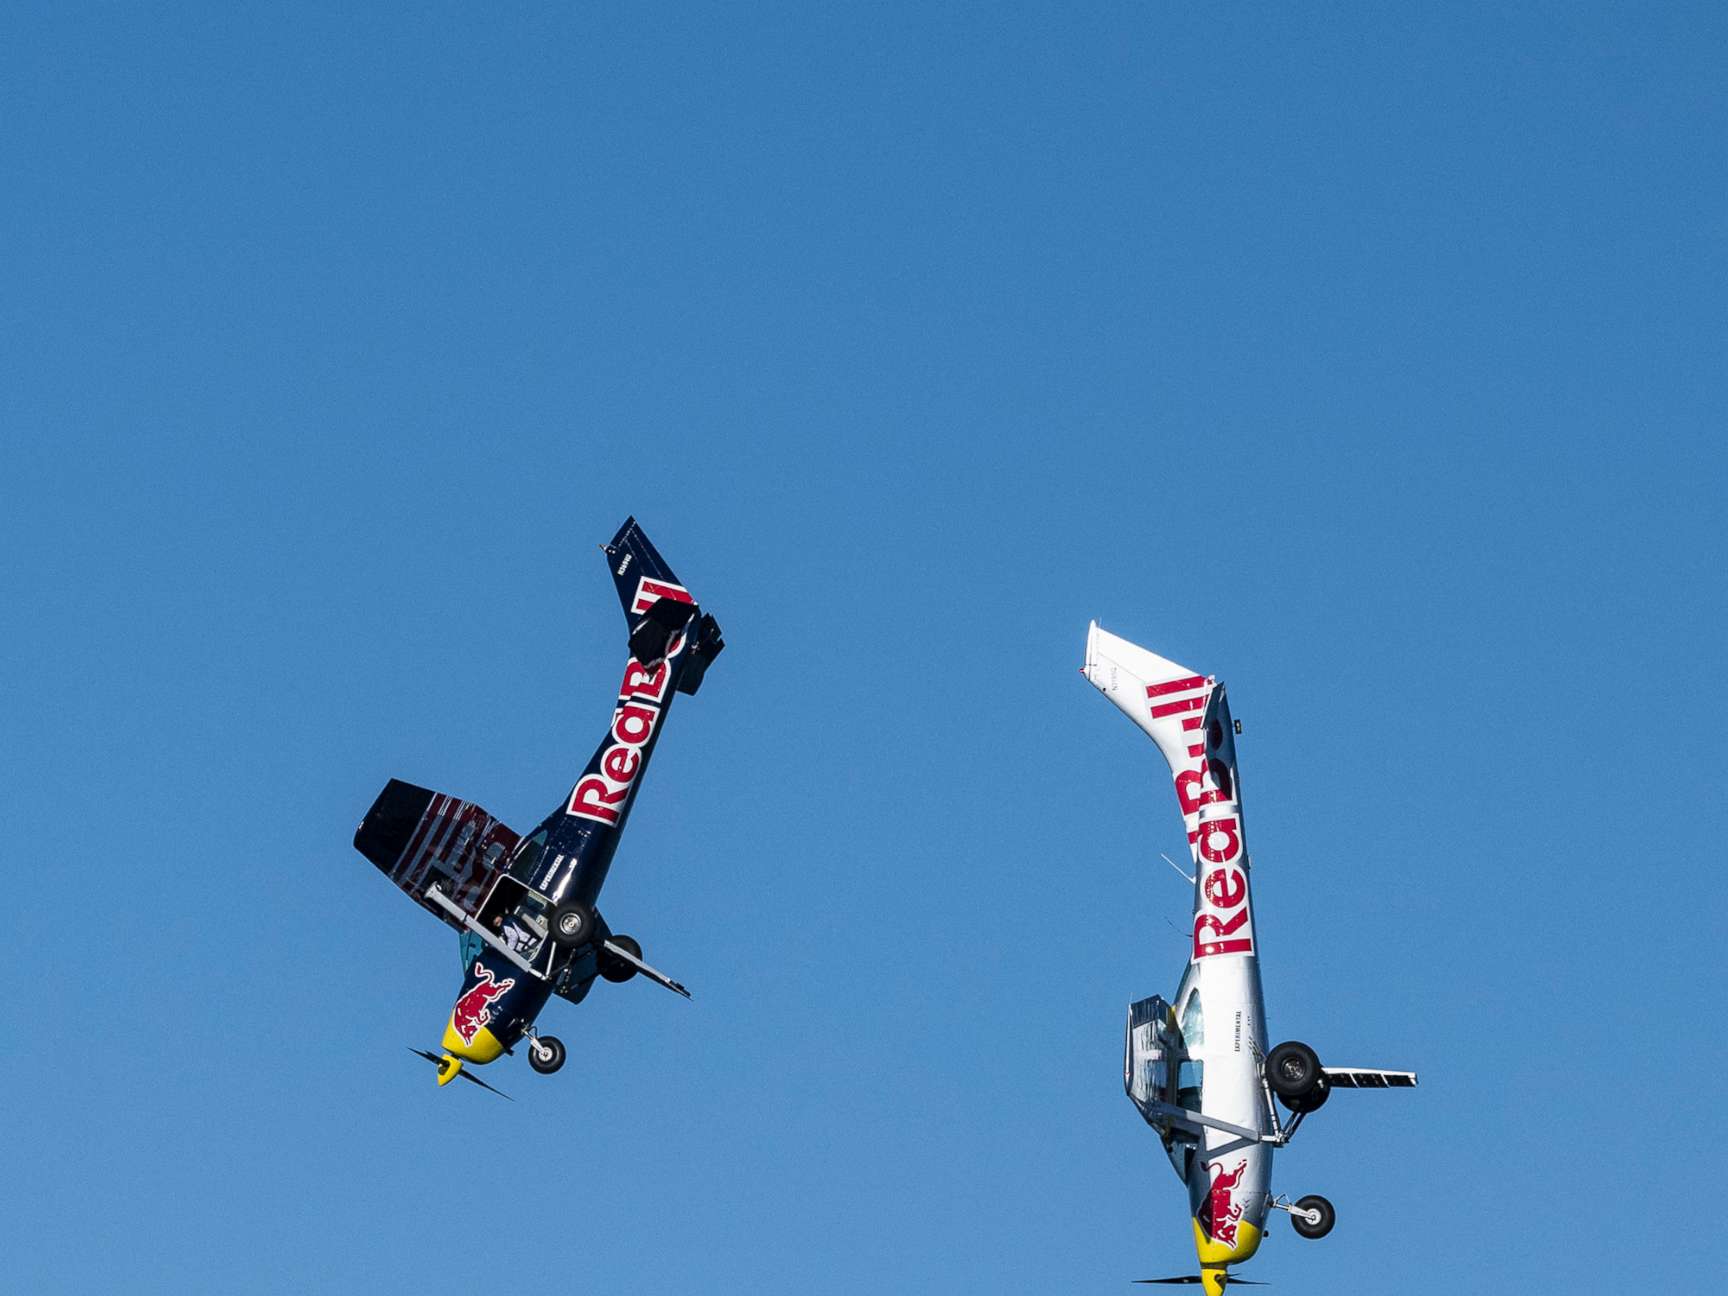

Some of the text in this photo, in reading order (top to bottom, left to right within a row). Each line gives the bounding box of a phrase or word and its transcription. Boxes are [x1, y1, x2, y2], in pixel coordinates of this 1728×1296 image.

[567, 576, 698, 827] Red Bl
[1188, 816, 1254, 961] Red
[1234, 1010, 1242, 1052] EXPERIMENTAL
